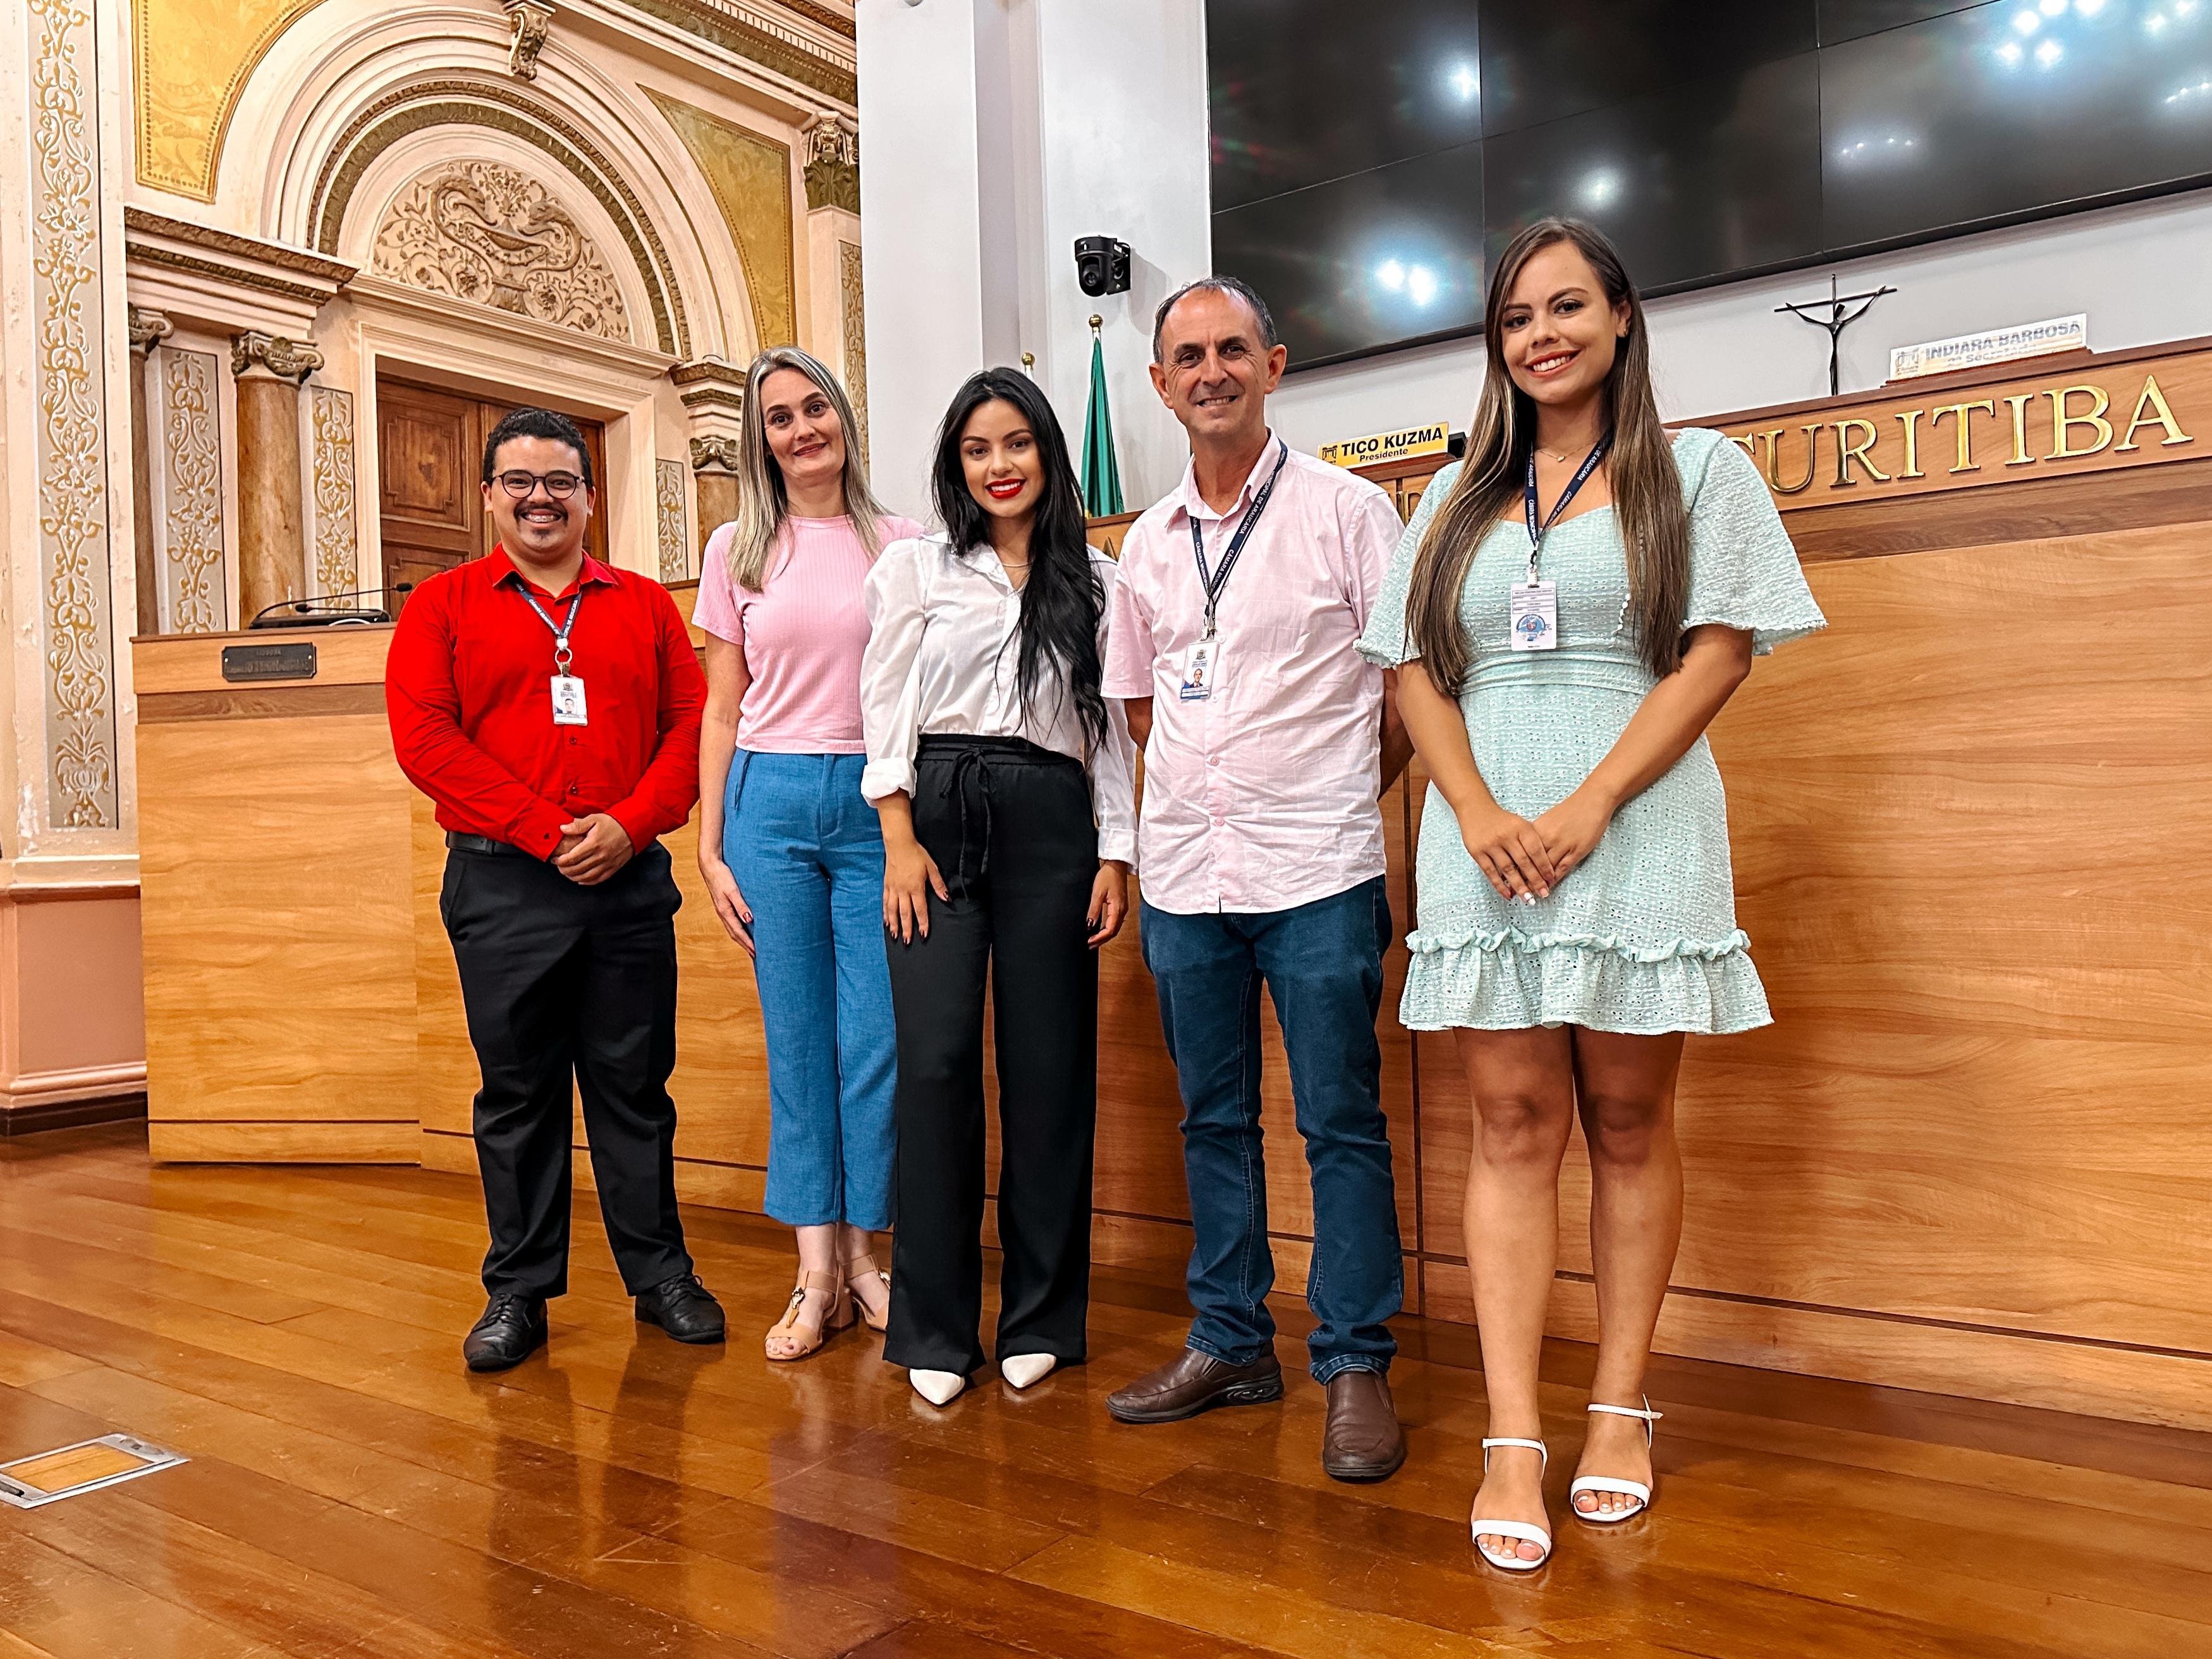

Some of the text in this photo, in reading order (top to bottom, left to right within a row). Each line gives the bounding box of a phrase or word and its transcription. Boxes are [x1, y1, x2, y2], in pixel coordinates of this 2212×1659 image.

[1926, 336, 1993, 360] INDIARA
[1341, 427, 1443, 456] TICO KUZMA
[1728, 374, 2194, 495] URITIBA
[1359, 448, 1408, 462] Presidente
[1256, 496, 1264, 506] DE
[1239, 503, 1259, 535] ARAUCÁRIA
